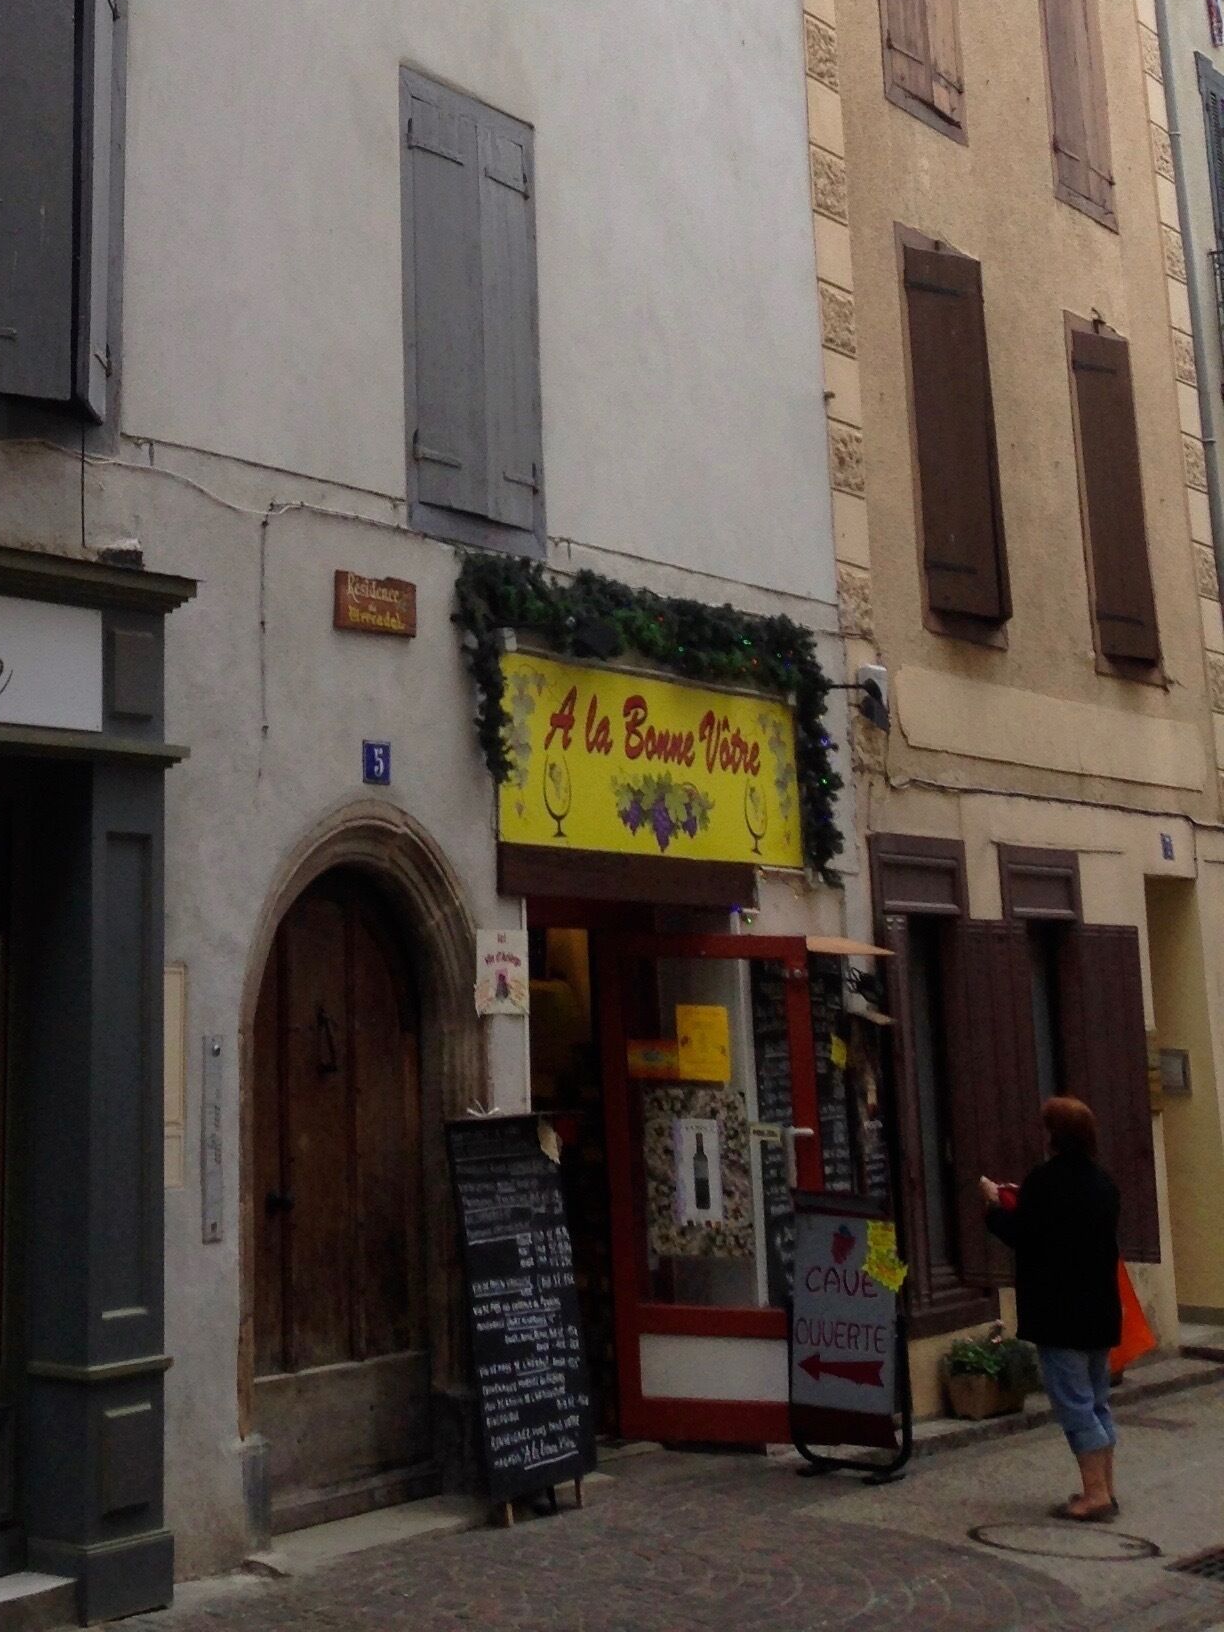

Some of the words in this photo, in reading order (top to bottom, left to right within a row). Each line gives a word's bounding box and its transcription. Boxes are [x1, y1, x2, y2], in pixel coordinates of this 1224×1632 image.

[544, 685, 577, 750] A
[585, 693, 613, 755] la
[623, 694, 695, 767] Bonne
[699, 709, 761, 776] Vôtre
[373, 746, 384, 778] 5
[806, 1265, 878, 1298] CAVE
[794, 1317, 888, 1353] OUVERTE
